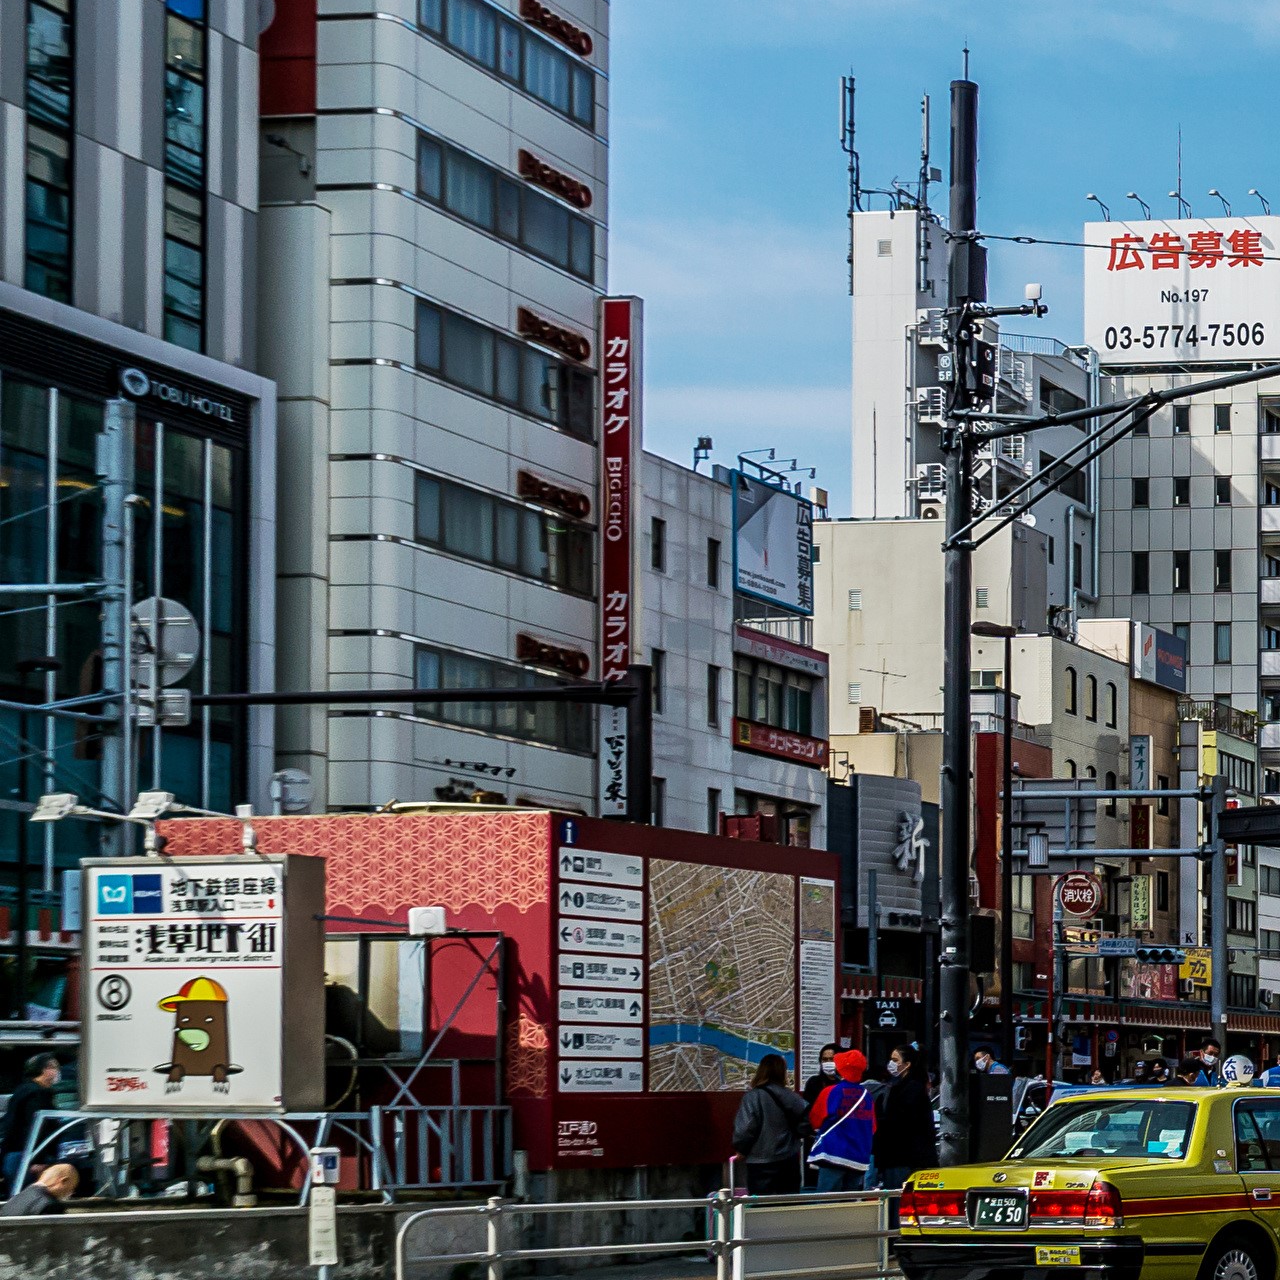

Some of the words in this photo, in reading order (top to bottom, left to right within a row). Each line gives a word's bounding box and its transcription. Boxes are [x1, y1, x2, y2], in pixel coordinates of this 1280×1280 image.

[1107, 229, 1265, 272] 広告募集
[1160, 289, 1209, 303] No.197
[1105, 322, 1265, 350] 03-5774-7506
[604, 336, 630, 435] カラオケ
[151, 381, 190, 410] TOBU
[191, 390, 235, 423] HOTEL
[796, 499, 814, 610] 広告募集
[604, 590, 628, 681] カラオケ
[1134, 744, 1147, 790] オオノ
[170, 877, 278, 897] 地下鉄銀座線
[1064, 889, 1093, 904] 消火栓
[171, 898, 236, 913] 浅草駅入口
[135, 922, 277, 955] 浅草地下街
[1185, 933, 1194, 943] K
[875, 1001, 899, 1009] TAXI
[1224, 1060, 1237, 1081] 大和
[558, 1121, 597, 1135] 江戸通り
[1004, 1198, 1017, 1207] 500
